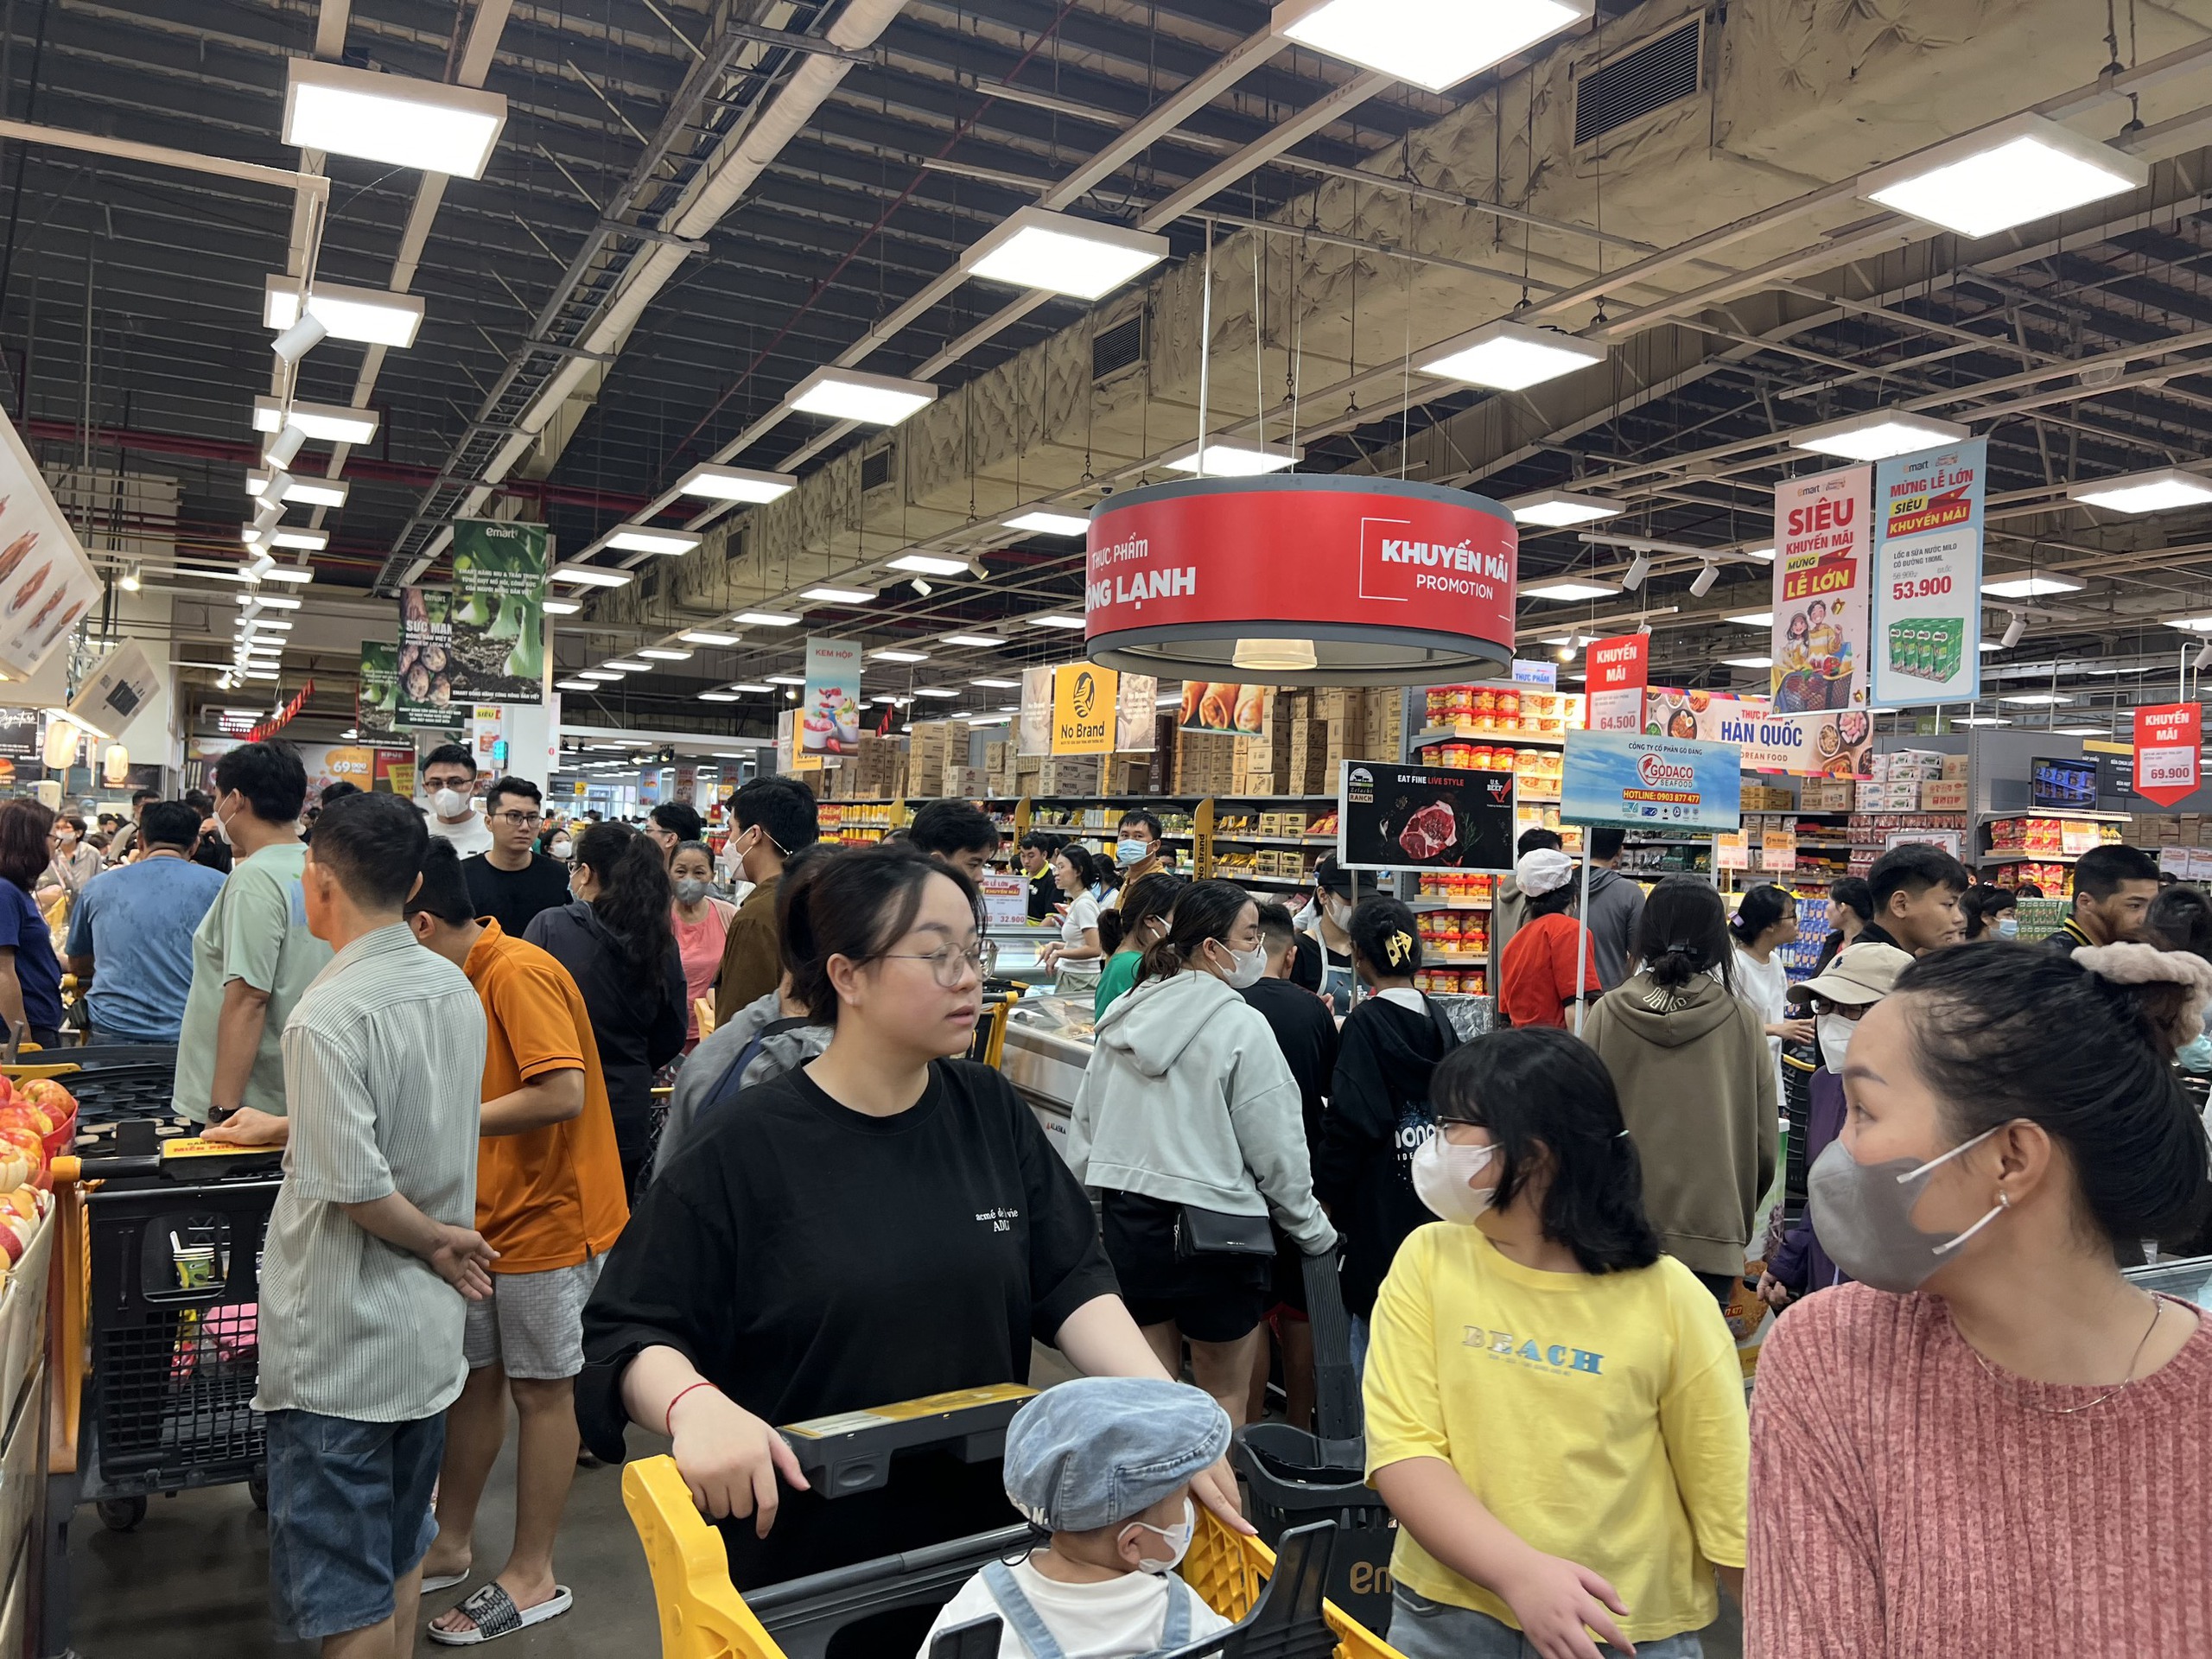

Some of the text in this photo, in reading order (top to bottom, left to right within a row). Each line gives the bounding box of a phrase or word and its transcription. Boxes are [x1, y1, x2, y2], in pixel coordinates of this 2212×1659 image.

[1931, 469, 1945, 489] LỄ
[1949, 467, 1974, 486] LỚN
[1796, 484, 1820, 497] emart
[1894, 498, 1923, 515] SIÊU
[1787, 496, 1854, 537] SIÊU
[1889, 512, 1940, 535] KHUYẾN
[486, 527, 515, 539] emart
[1786, 529, 1853, 556] KHUYẾN MÃI
[1091, 531, 1148, 571] THỰC PHẨM
[1382, 538, 1509, 583] KHUYẾN MÃI
[1788, 556, 1816, 571] MỪNG
[1085, 566, 1197, 614] ÔNG LẠNH
[1416, 574, 1494, 601] PROMOTION
[1786, 568, 1849, 598] LỄ LỚN
[1892, 575, 1952, 601] 53.900
[406, 619, 428, 632] SỨC
[815, 649, 854, 660] KEM HỘP
[1596, 642, 1637, 664] KHUYẾN
[1605, 664, 1626, 683] MÃI
[1600, 715, 1636, 730] 64.500
[1741, 709, 1761, 721] THỰC
[2145, 709, 2190, 726] KHUYẾN
[1060, 721, 1105, 739] No Brand
[1721, 716, 1802, 747] HÀN QUỐC
[2156, 727, 2178, 741] MÃI
[1628, 741, 1645, 751] CÔNG
[1740, 751, 1789, 762] OREAN FOOD
[334, 760, 351, 772] 69
[1650, 764, 1694, 779] GODACO
[2151, 767, 2190, 779] 69.900
[1397, 774, 1465, 786] EAT FINE LIVE STYLE
[1660, 779, 1693, 788] SEAFOOD
[1623, 790, 1700, 804] HOTLINE: 0903 877 477
[1198, 866, 1205, 880] No
[1007, 1208, 1019, 1218] vie
[1462, 1325, 1605, 1375] BEACH
